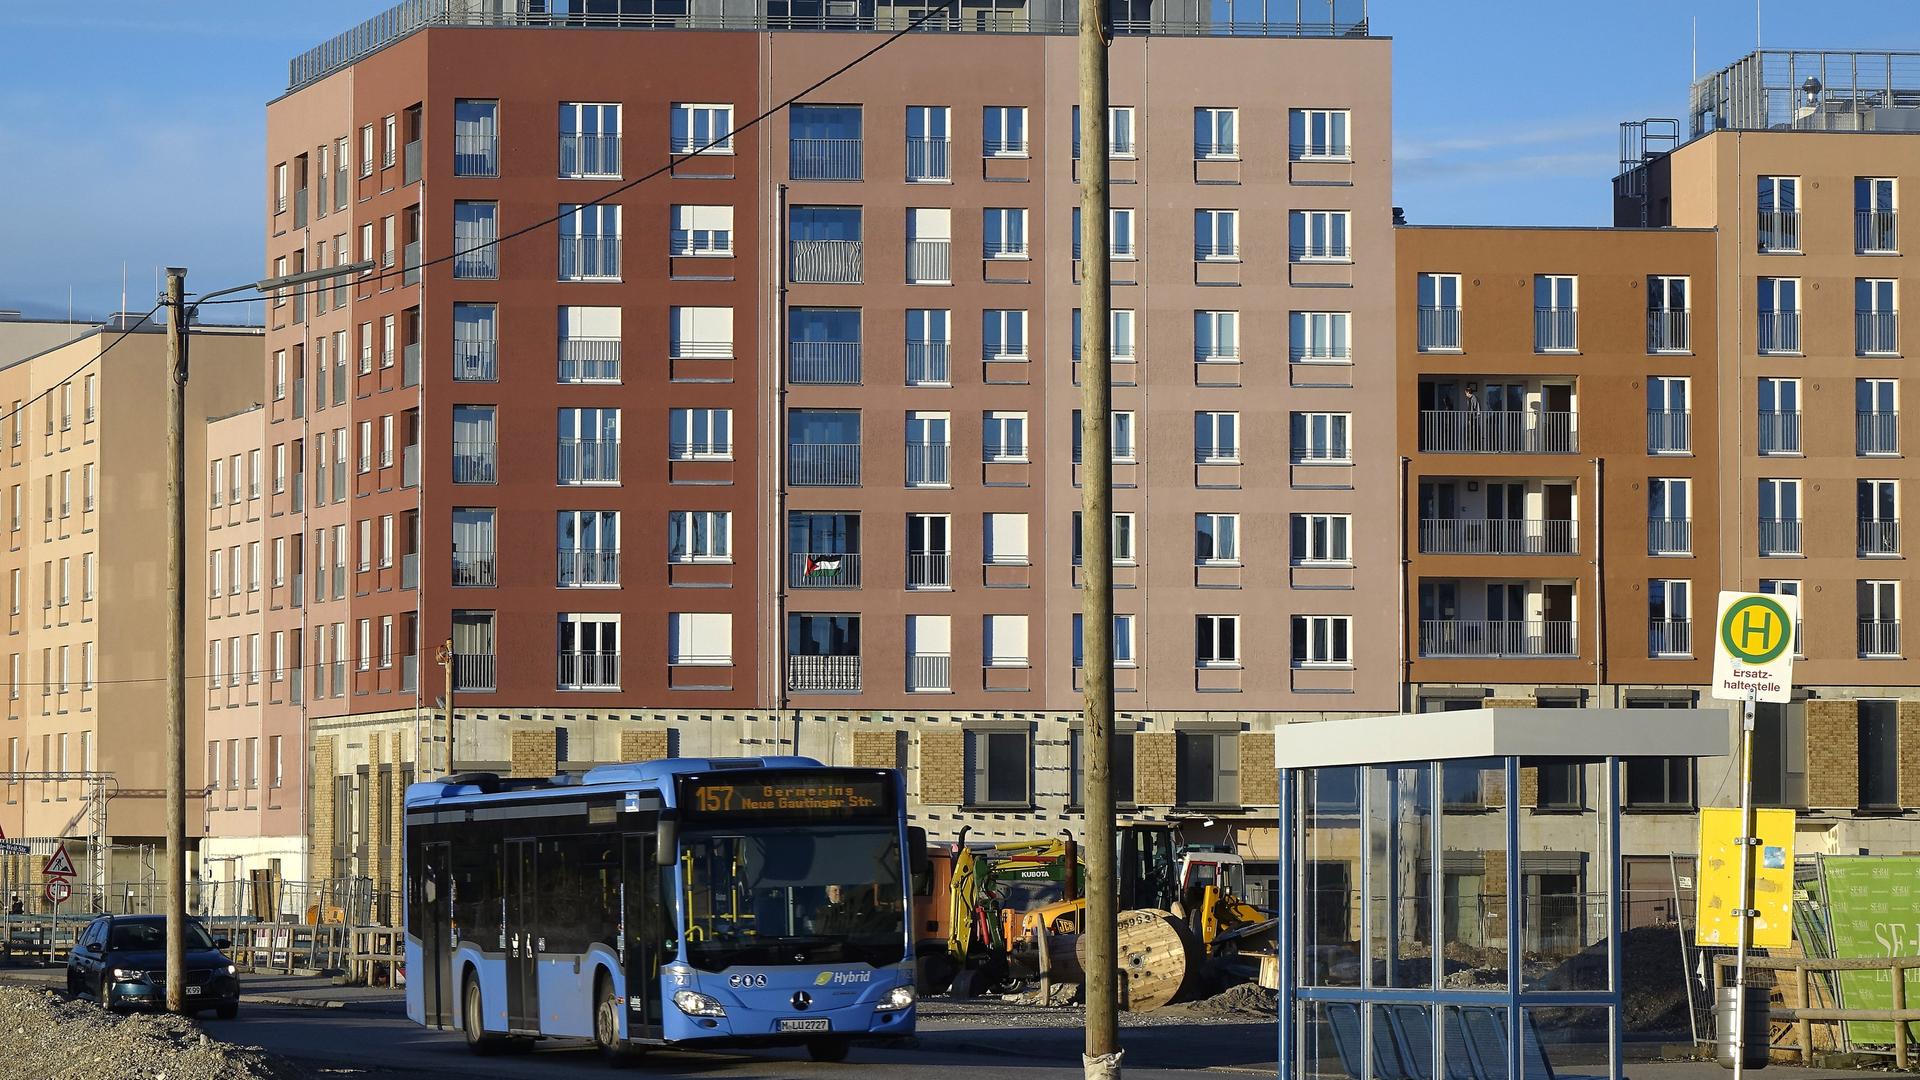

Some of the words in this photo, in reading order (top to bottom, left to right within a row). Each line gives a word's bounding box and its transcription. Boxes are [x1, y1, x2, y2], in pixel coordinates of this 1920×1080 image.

[1742, 611, 1771, 649] H
[1733, 669, 1773, 679] Ersatz-
[1723, 679, 1781, 692] haltestelle
[696, 785, 734, 812] 157
[763, 785, 854, 798] Germering
[742, 798, 774, 810] Neue
[779, 797, 844, 810] Gautinger
[849, 796, 876, 808] Str.
[834, 970, 871, 985] Hybrid
